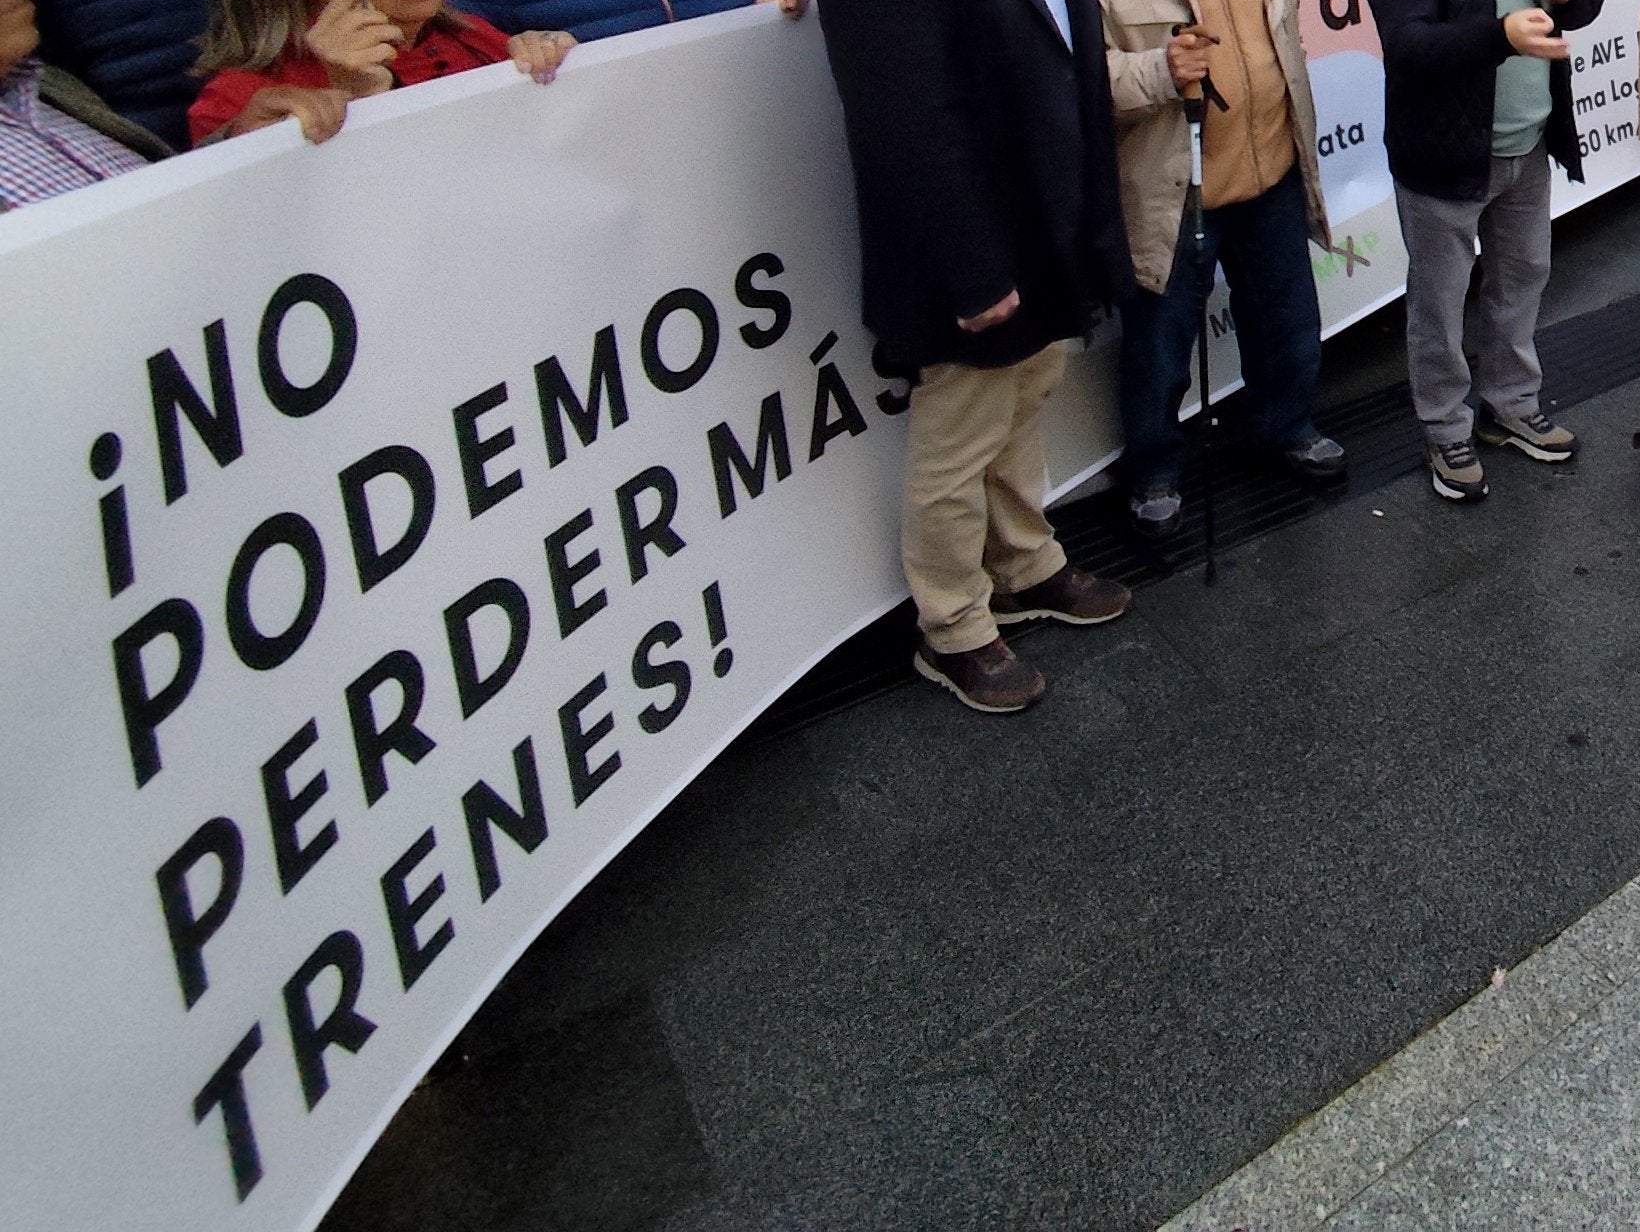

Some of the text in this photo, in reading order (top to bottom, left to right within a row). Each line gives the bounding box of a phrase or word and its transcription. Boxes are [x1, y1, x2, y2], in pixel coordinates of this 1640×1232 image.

[1570, 36, 1626, 75] e AVE
[1572, 90, 1606, 115] ma
[89, 273, 358, 597] ¡NO
[112, 253, 792, 788] PODEMOS
[155, 465, 687, 1011] PERDER
[192, 580, 735, 1204] TRENES!
